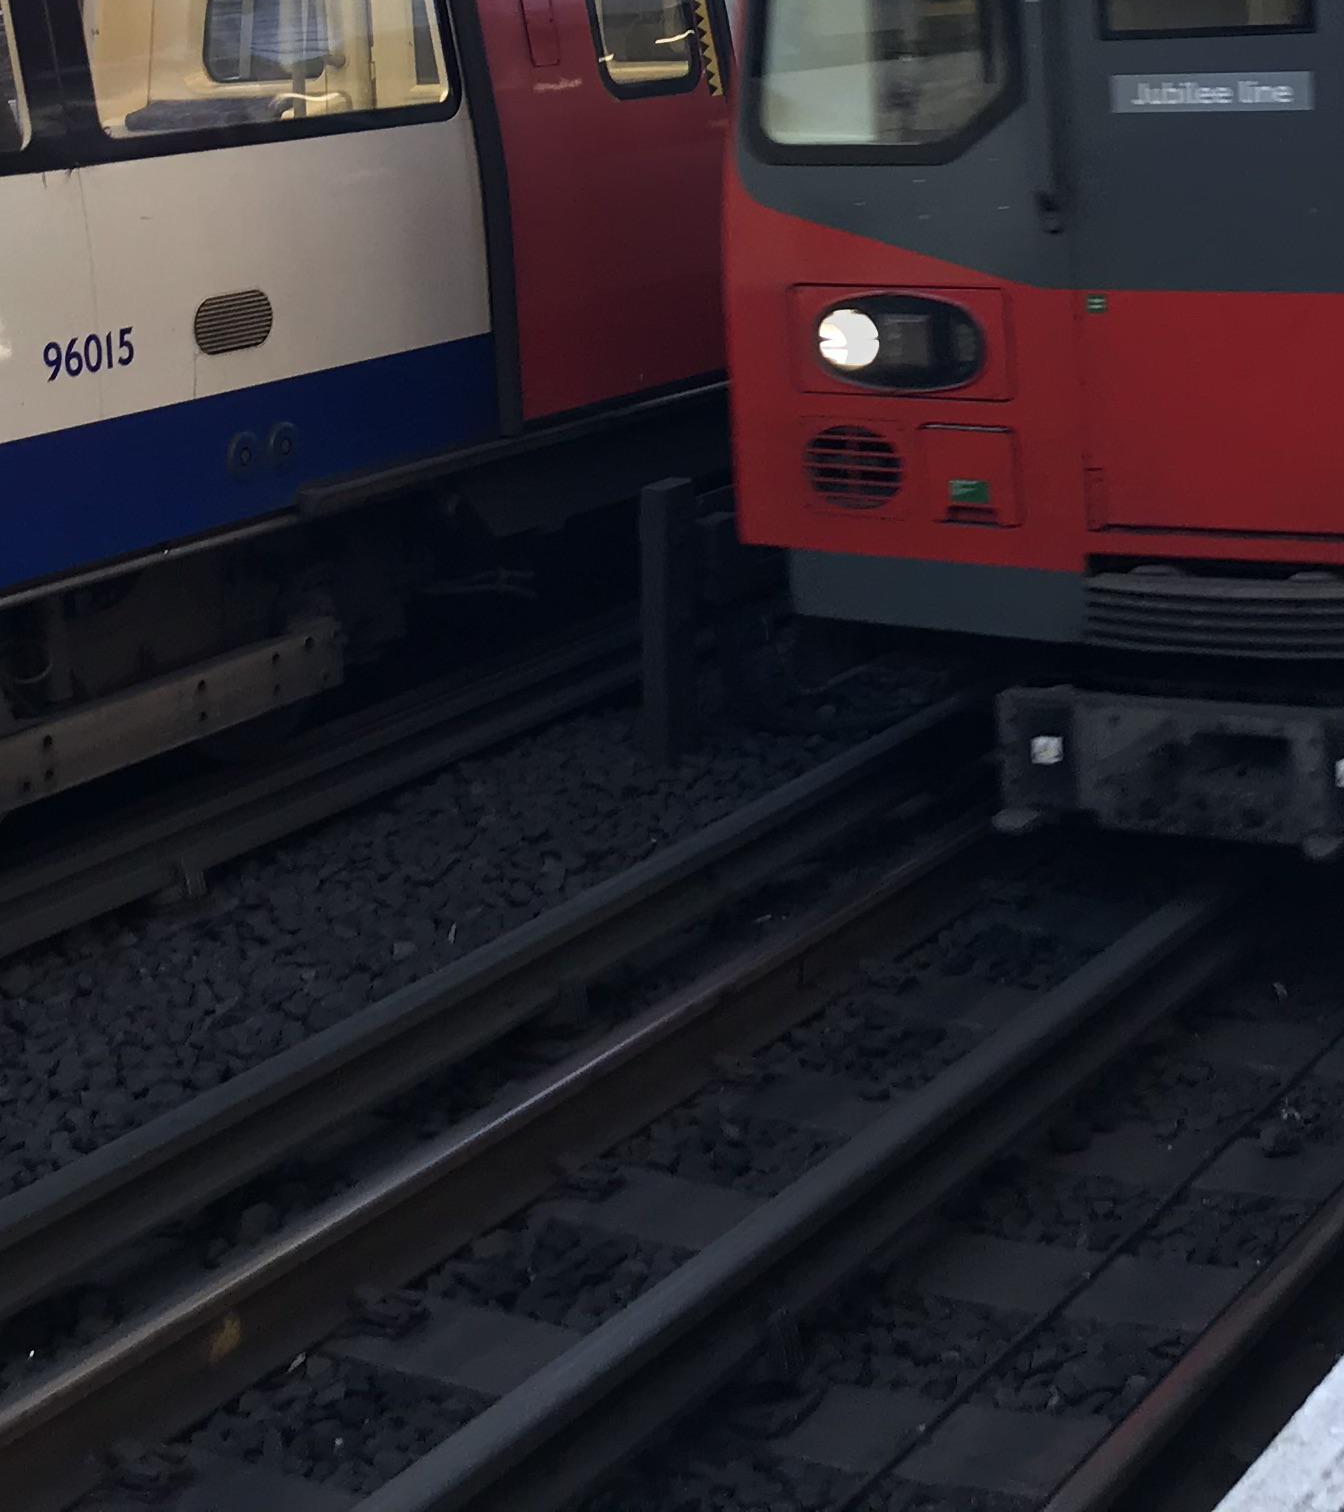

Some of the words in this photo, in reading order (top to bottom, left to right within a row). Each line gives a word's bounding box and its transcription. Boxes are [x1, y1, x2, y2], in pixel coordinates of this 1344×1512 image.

[1131, 81, 1234, 105] Jubilee
[1237, 79, 1296, 104] line
[42, 325, 135, 383] 96015
